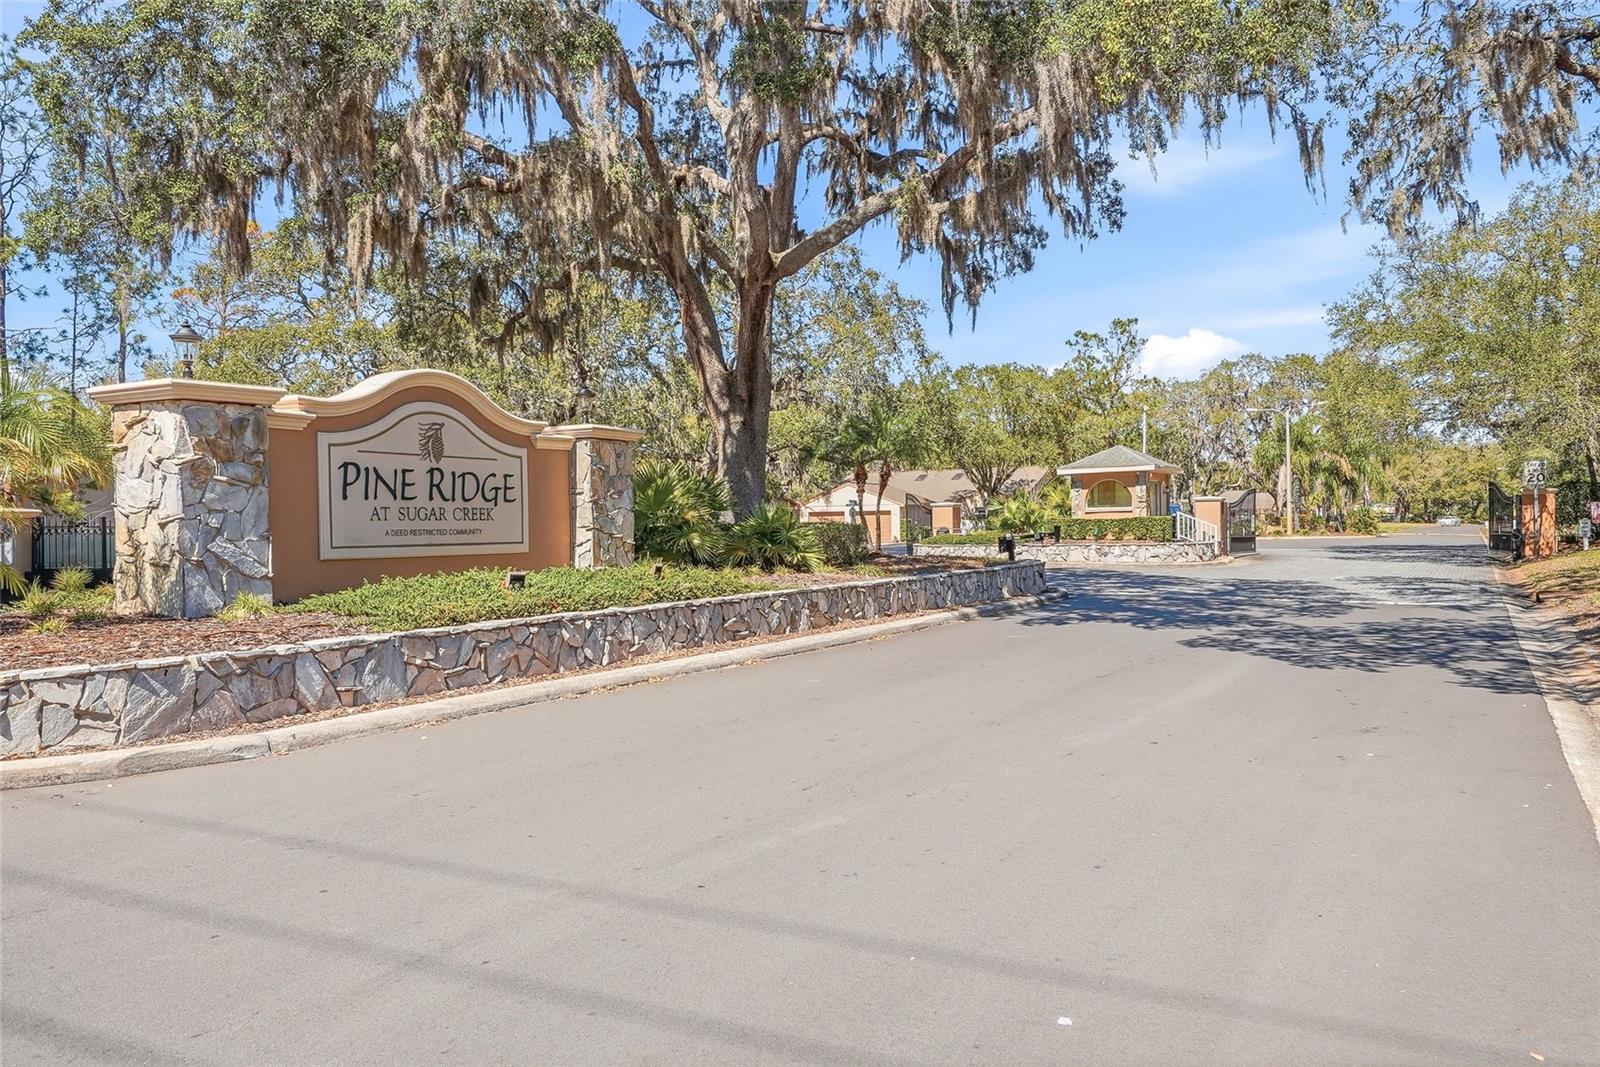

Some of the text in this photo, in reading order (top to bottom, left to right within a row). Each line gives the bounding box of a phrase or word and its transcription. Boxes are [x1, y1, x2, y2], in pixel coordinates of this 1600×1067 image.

[1527, 472, 1545, 482] 20
[338, 461, 517, 507] PINE RIDGE
[369, 506, 494, 521] AT SUGAR CREEK
[409, 528, 447, 536] RESTRICTED
[449, 528, 483, 536] COMMUNITY
